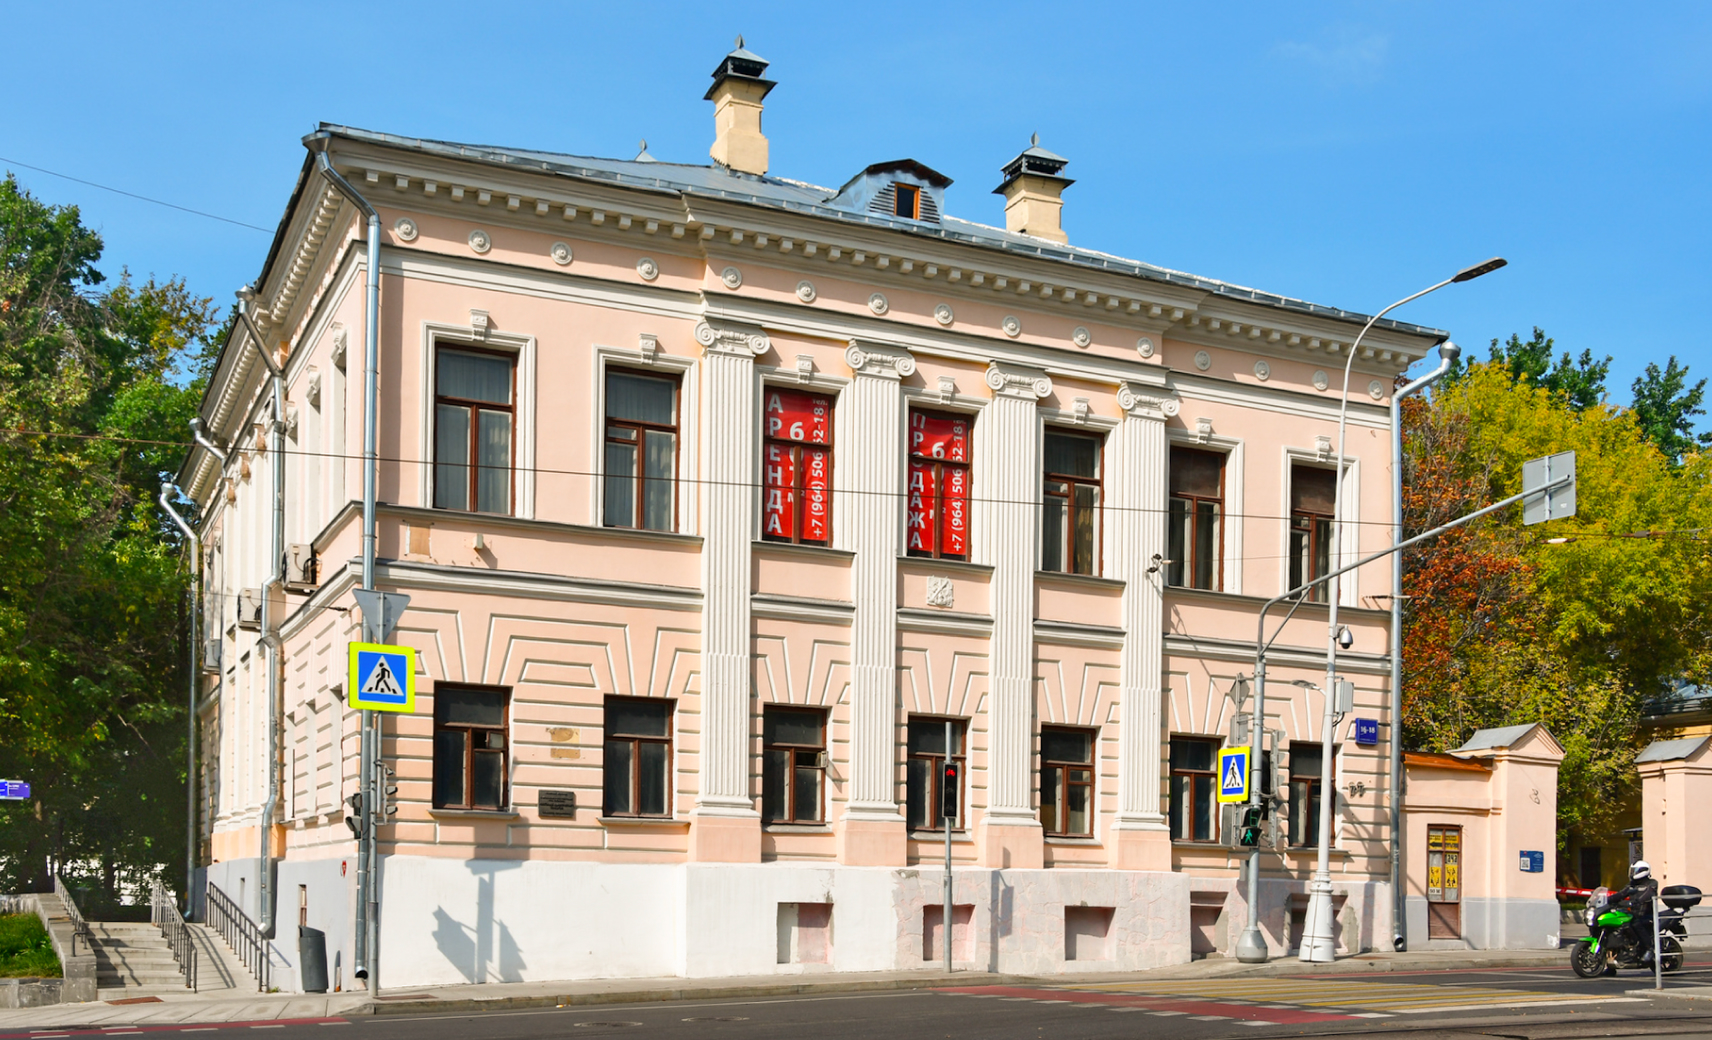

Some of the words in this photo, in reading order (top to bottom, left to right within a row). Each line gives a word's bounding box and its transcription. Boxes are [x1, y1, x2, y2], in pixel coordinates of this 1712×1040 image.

[768, 393, 784, 534] АРЕНДА
[909, 412, 926, 549] ПРОДАЖА
[811, 518, 823, 537] +7
[951, 533, 963, 552] +7
